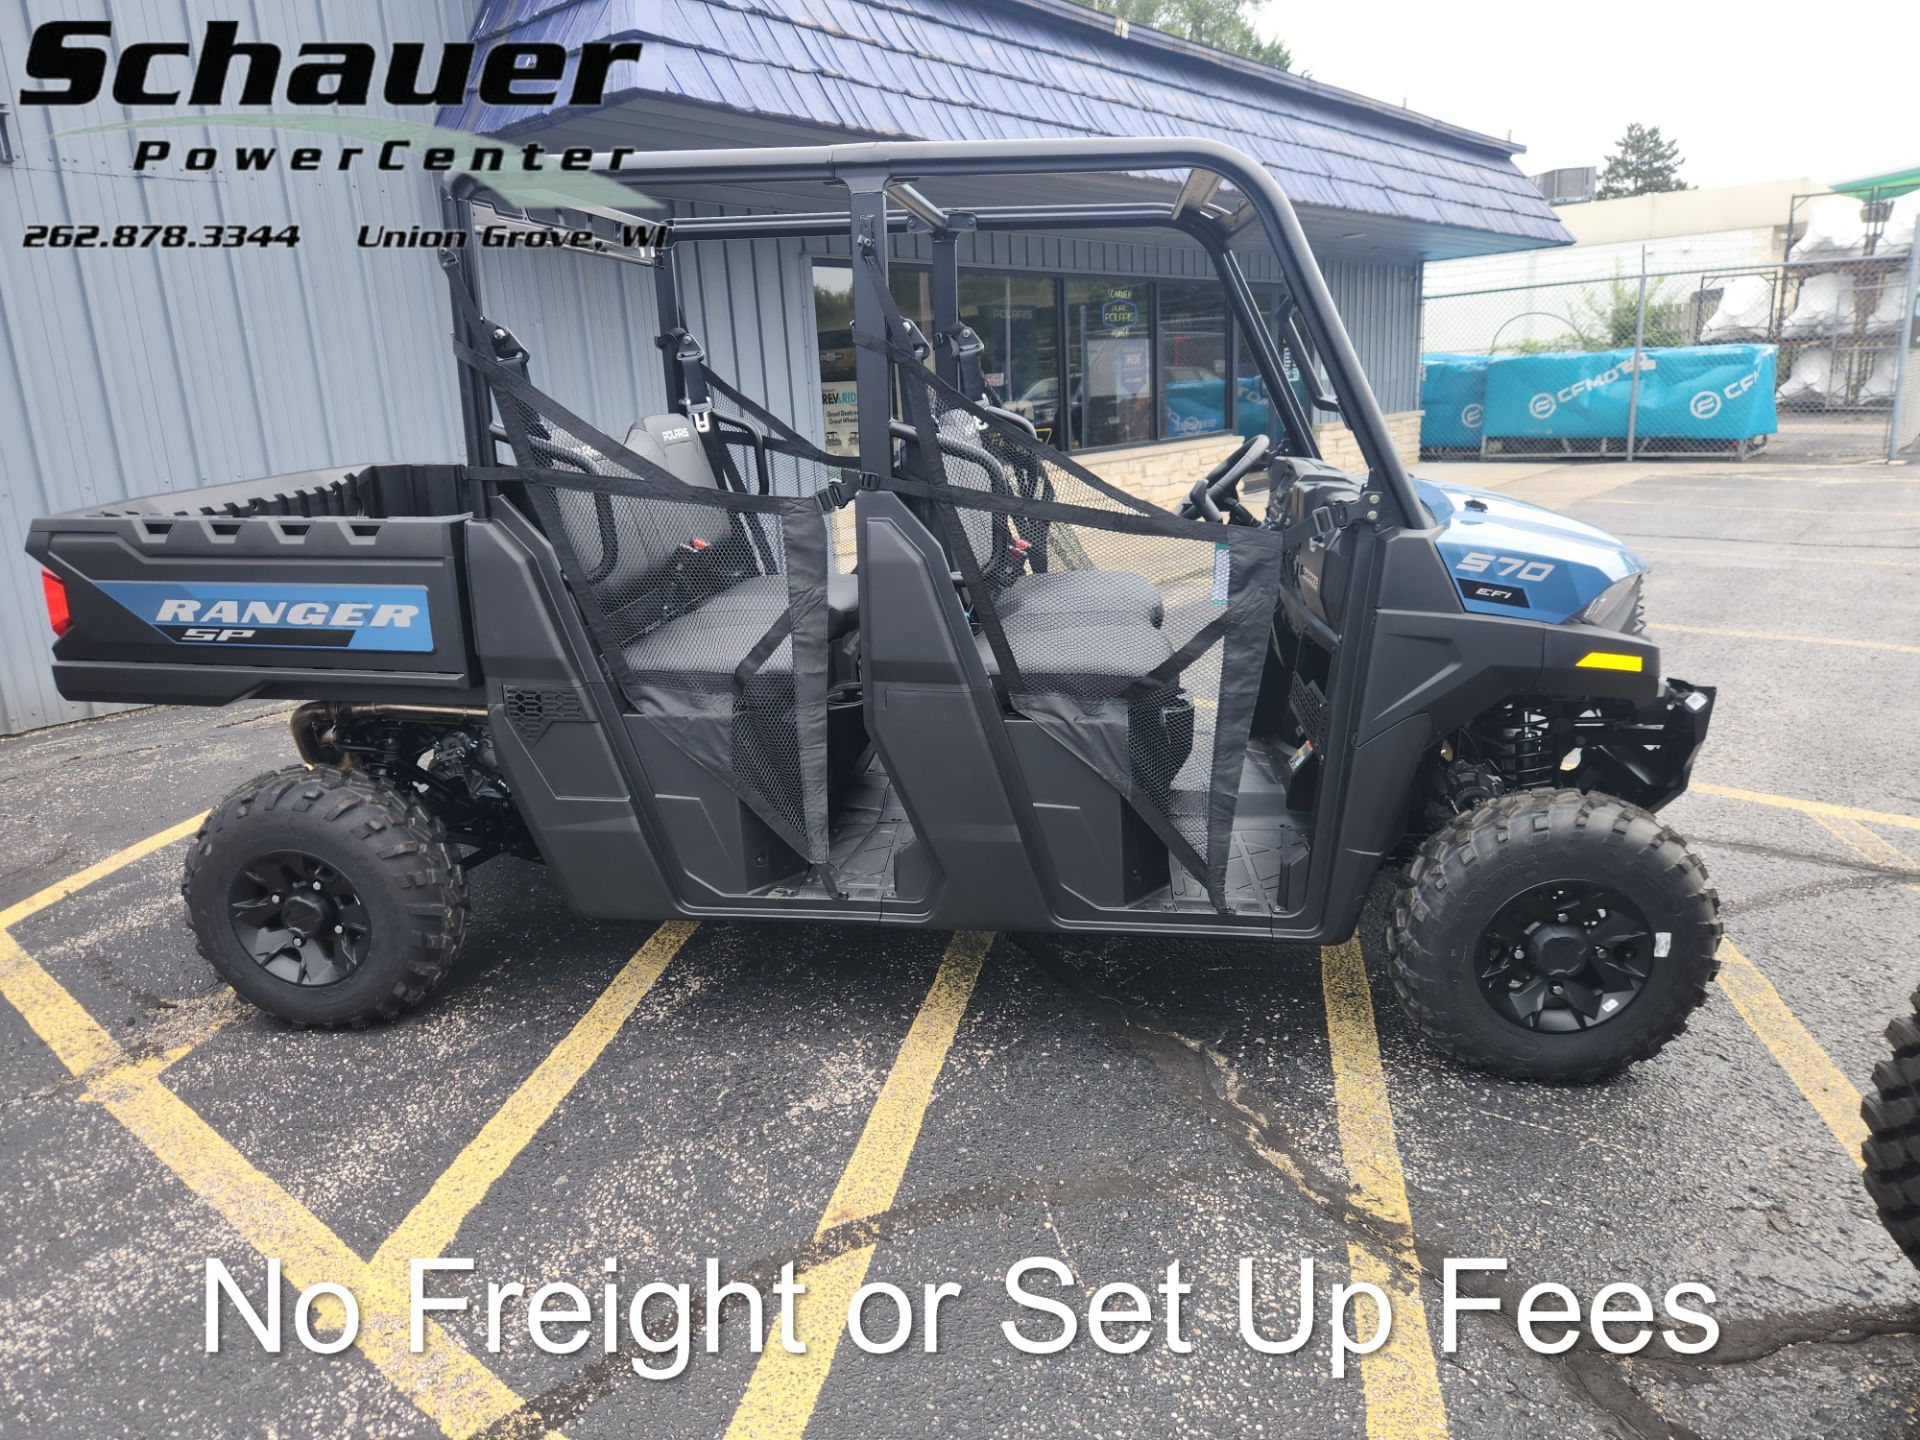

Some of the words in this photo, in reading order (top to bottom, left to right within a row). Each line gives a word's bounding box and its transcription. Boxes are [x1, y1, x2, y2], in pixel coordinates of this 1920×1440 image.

[662, 427, 690, 442] POLARIS
[1456, 552, 1555, 582] 570
[1475, 587, 1512, 600] EFI
[155, 599, 420, 628] RANGER
[181, 628, 256, 642] SP
